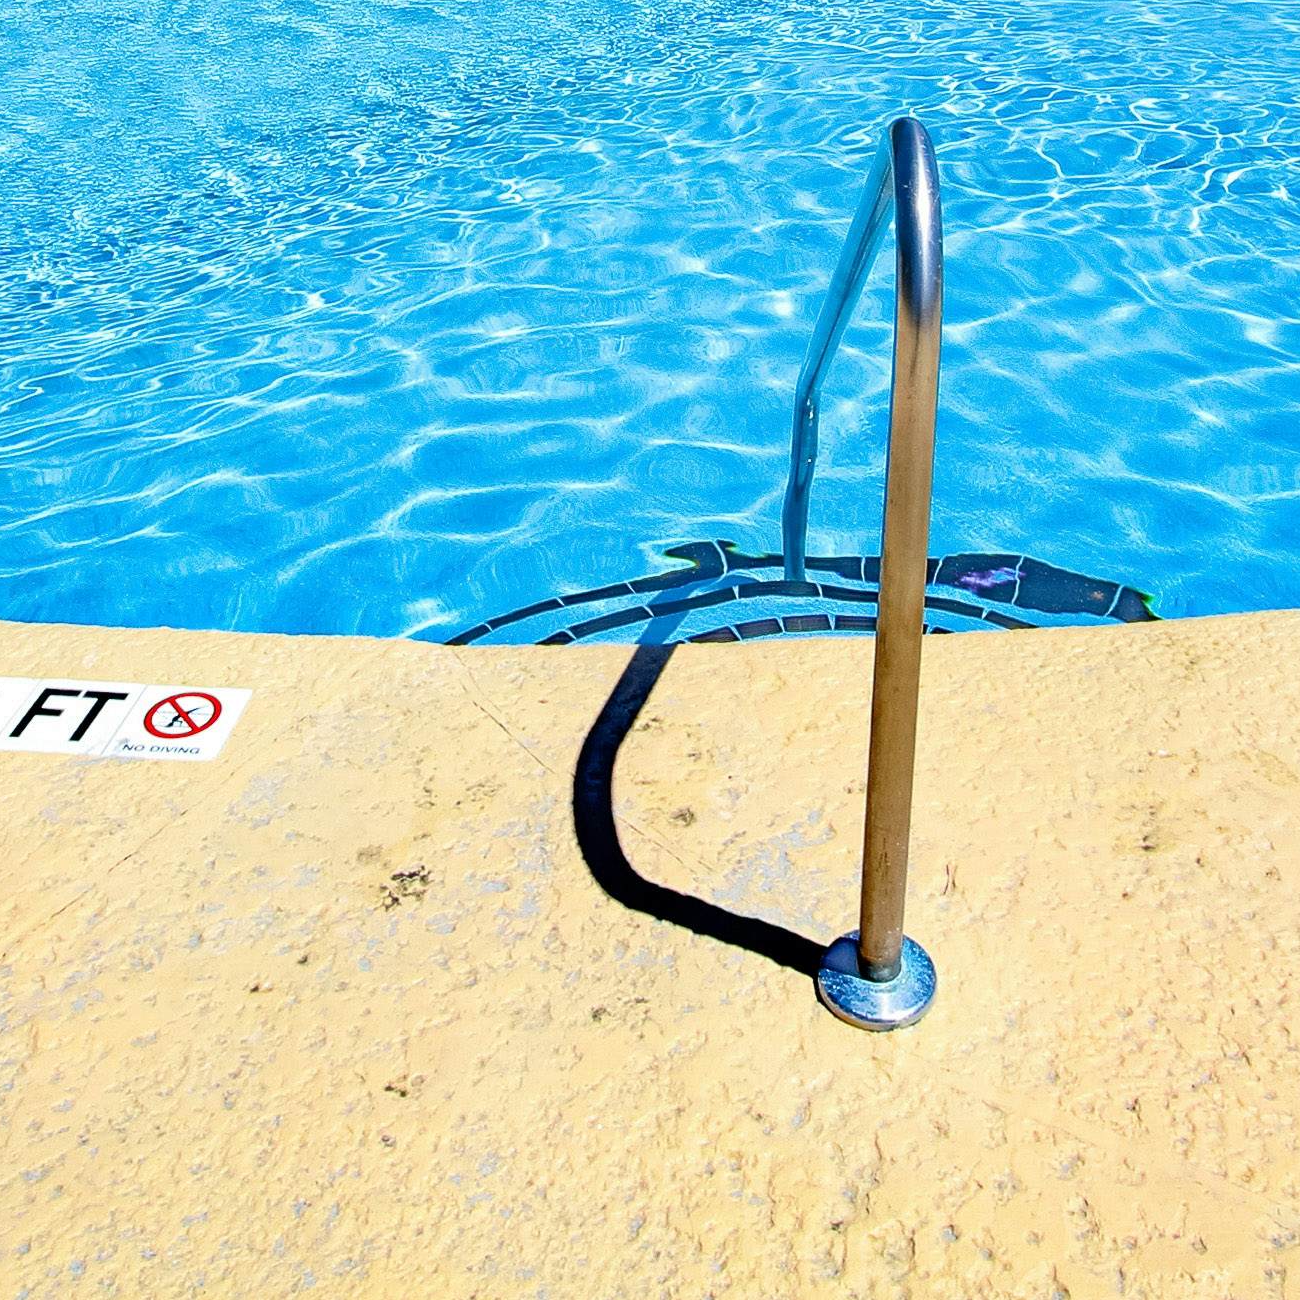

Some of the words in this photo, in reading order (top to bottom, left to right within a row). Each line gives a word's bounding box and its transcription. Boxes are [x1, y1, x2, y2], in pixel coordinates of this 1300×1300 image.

[8, 686, 129, 742] FT
[122, 743, 145, 752] NO
[149, 744, 200, 755] DIVING
